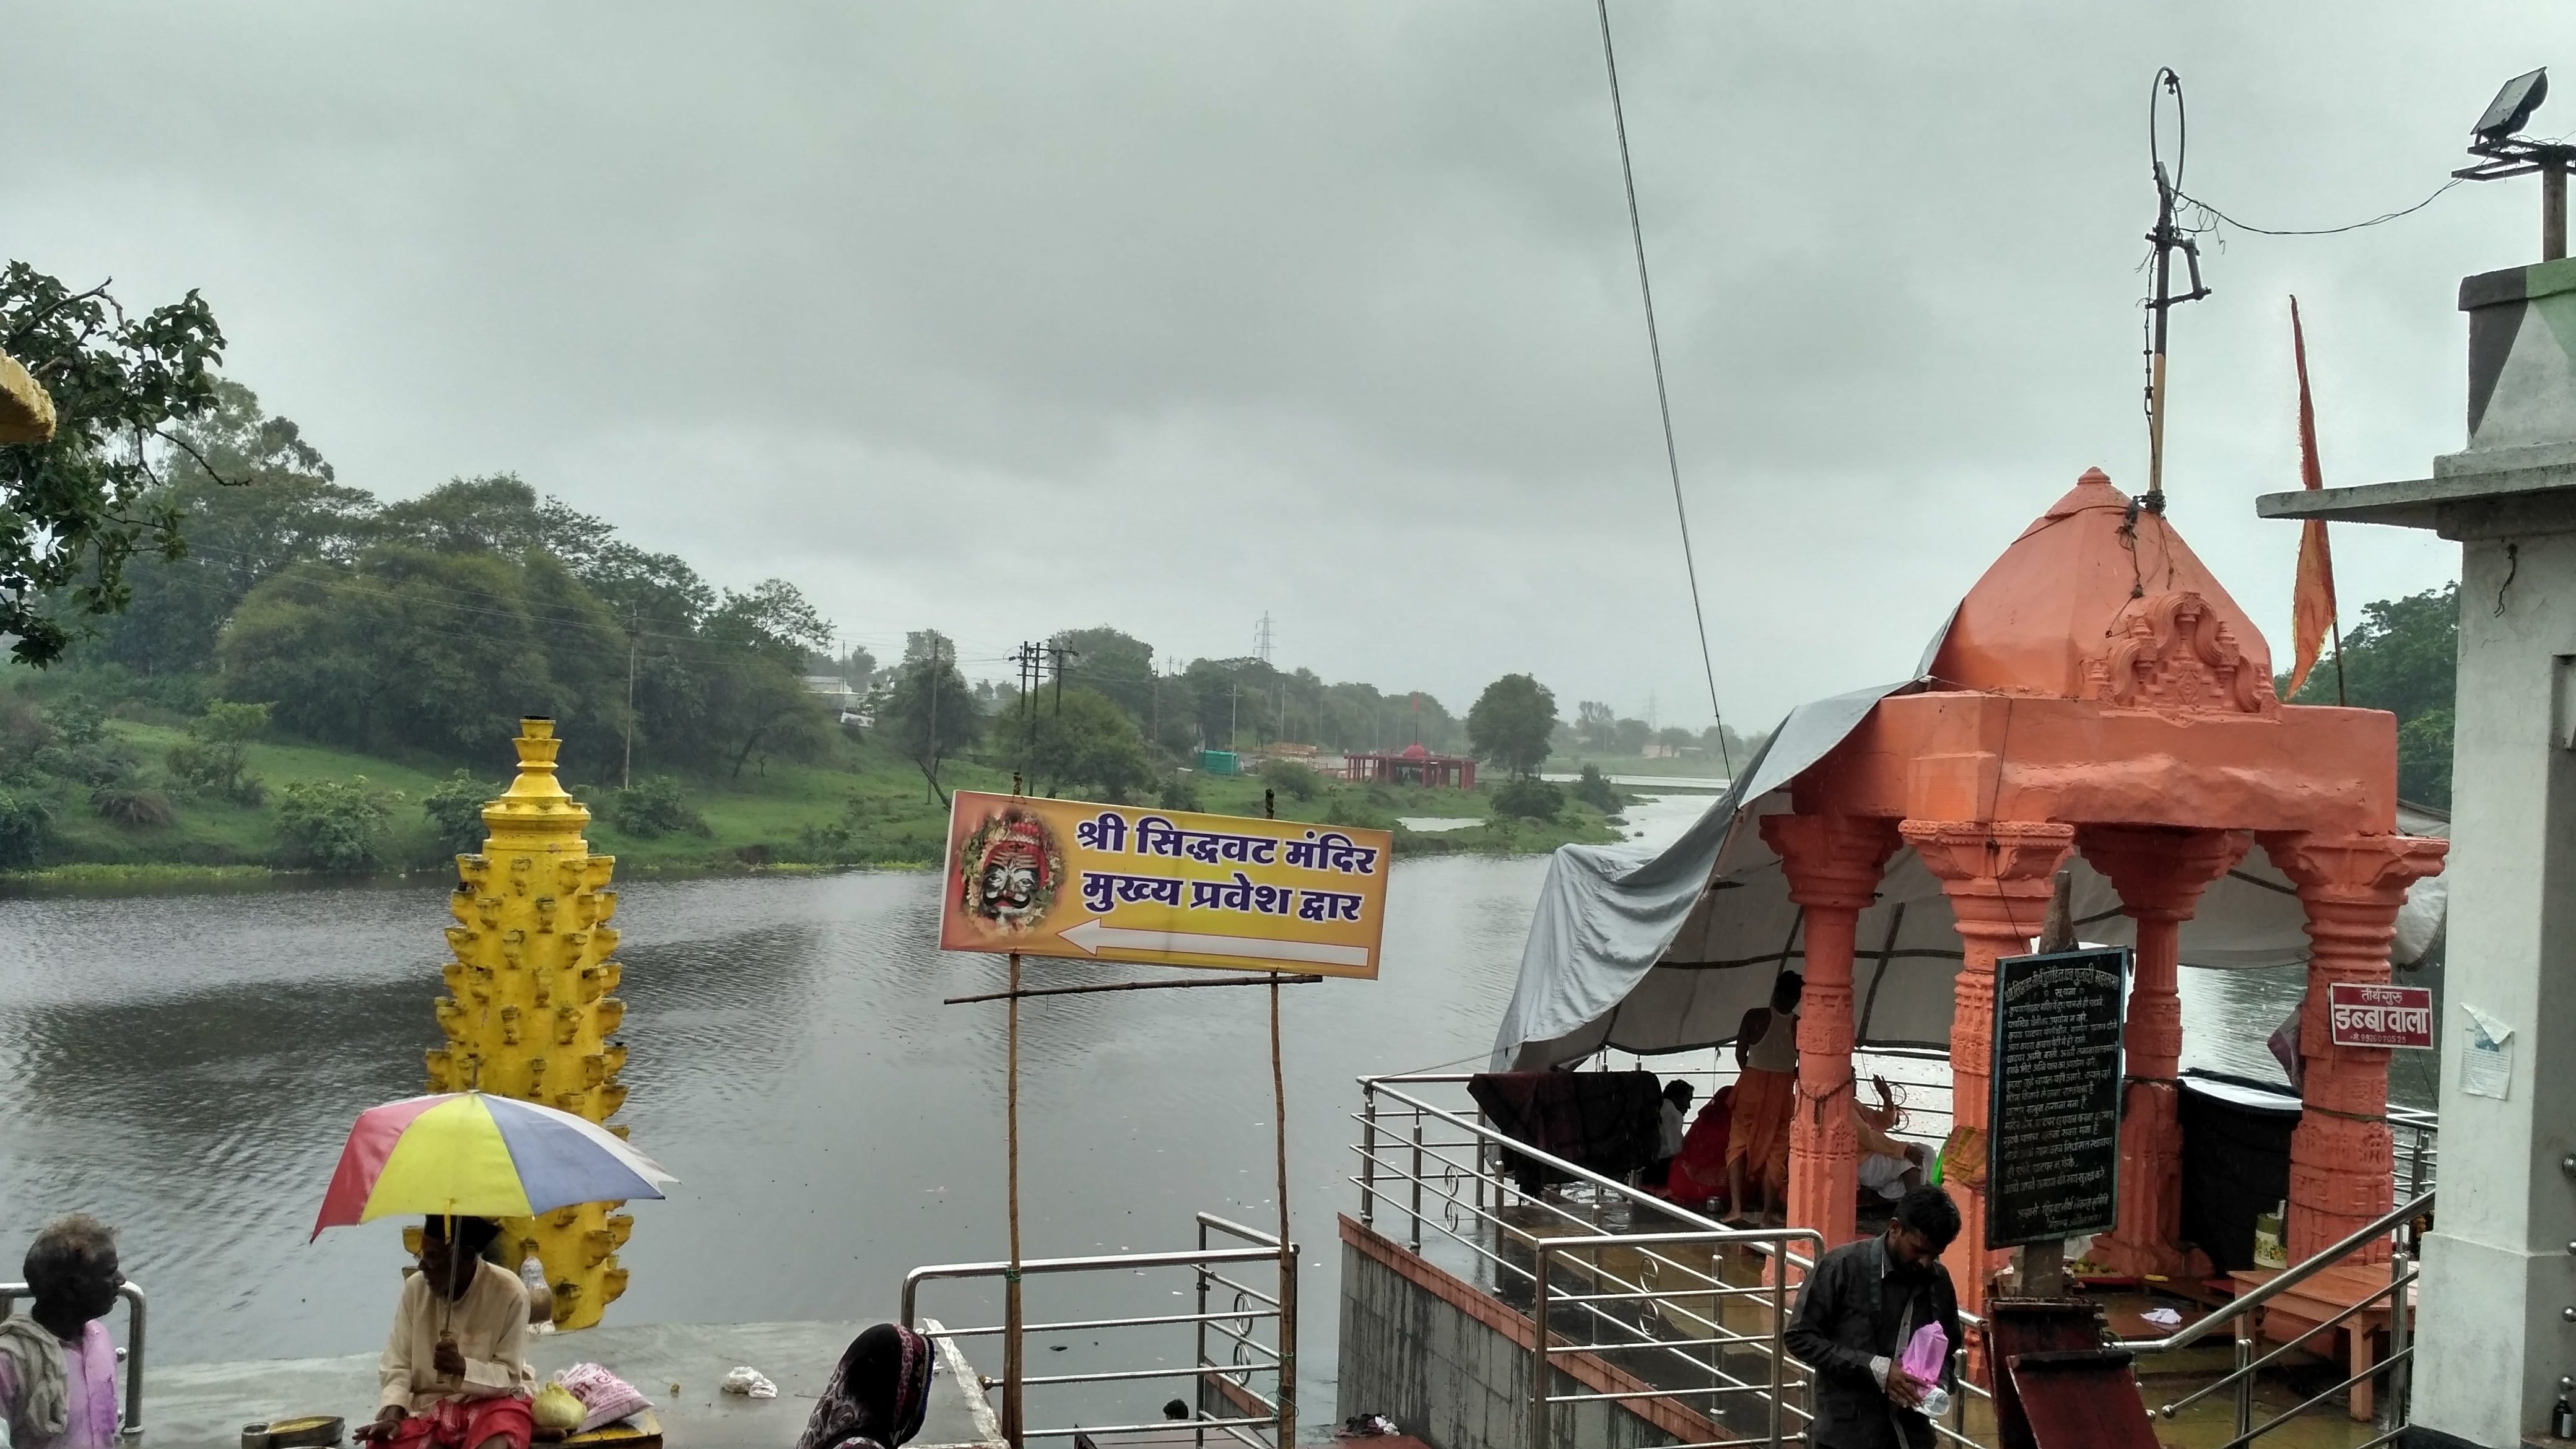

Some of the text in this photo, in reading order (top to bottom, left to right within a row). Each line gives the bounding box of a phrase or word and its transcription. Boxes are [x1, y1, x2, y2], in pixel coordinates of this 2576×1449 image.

[1076, 811, 1378, 874] श्री सिद्धवट मंदिर
[1082, 872, 1363, 923] मुख्य प्रवेश द्वार
[2004, 982, 2013, 1002] श्री
[2074, 962, 2095, 986] पुजारी
[2095, 970, 2120, 990] महासभा
[2361, 1033, 2406, 1043] 9926070525
